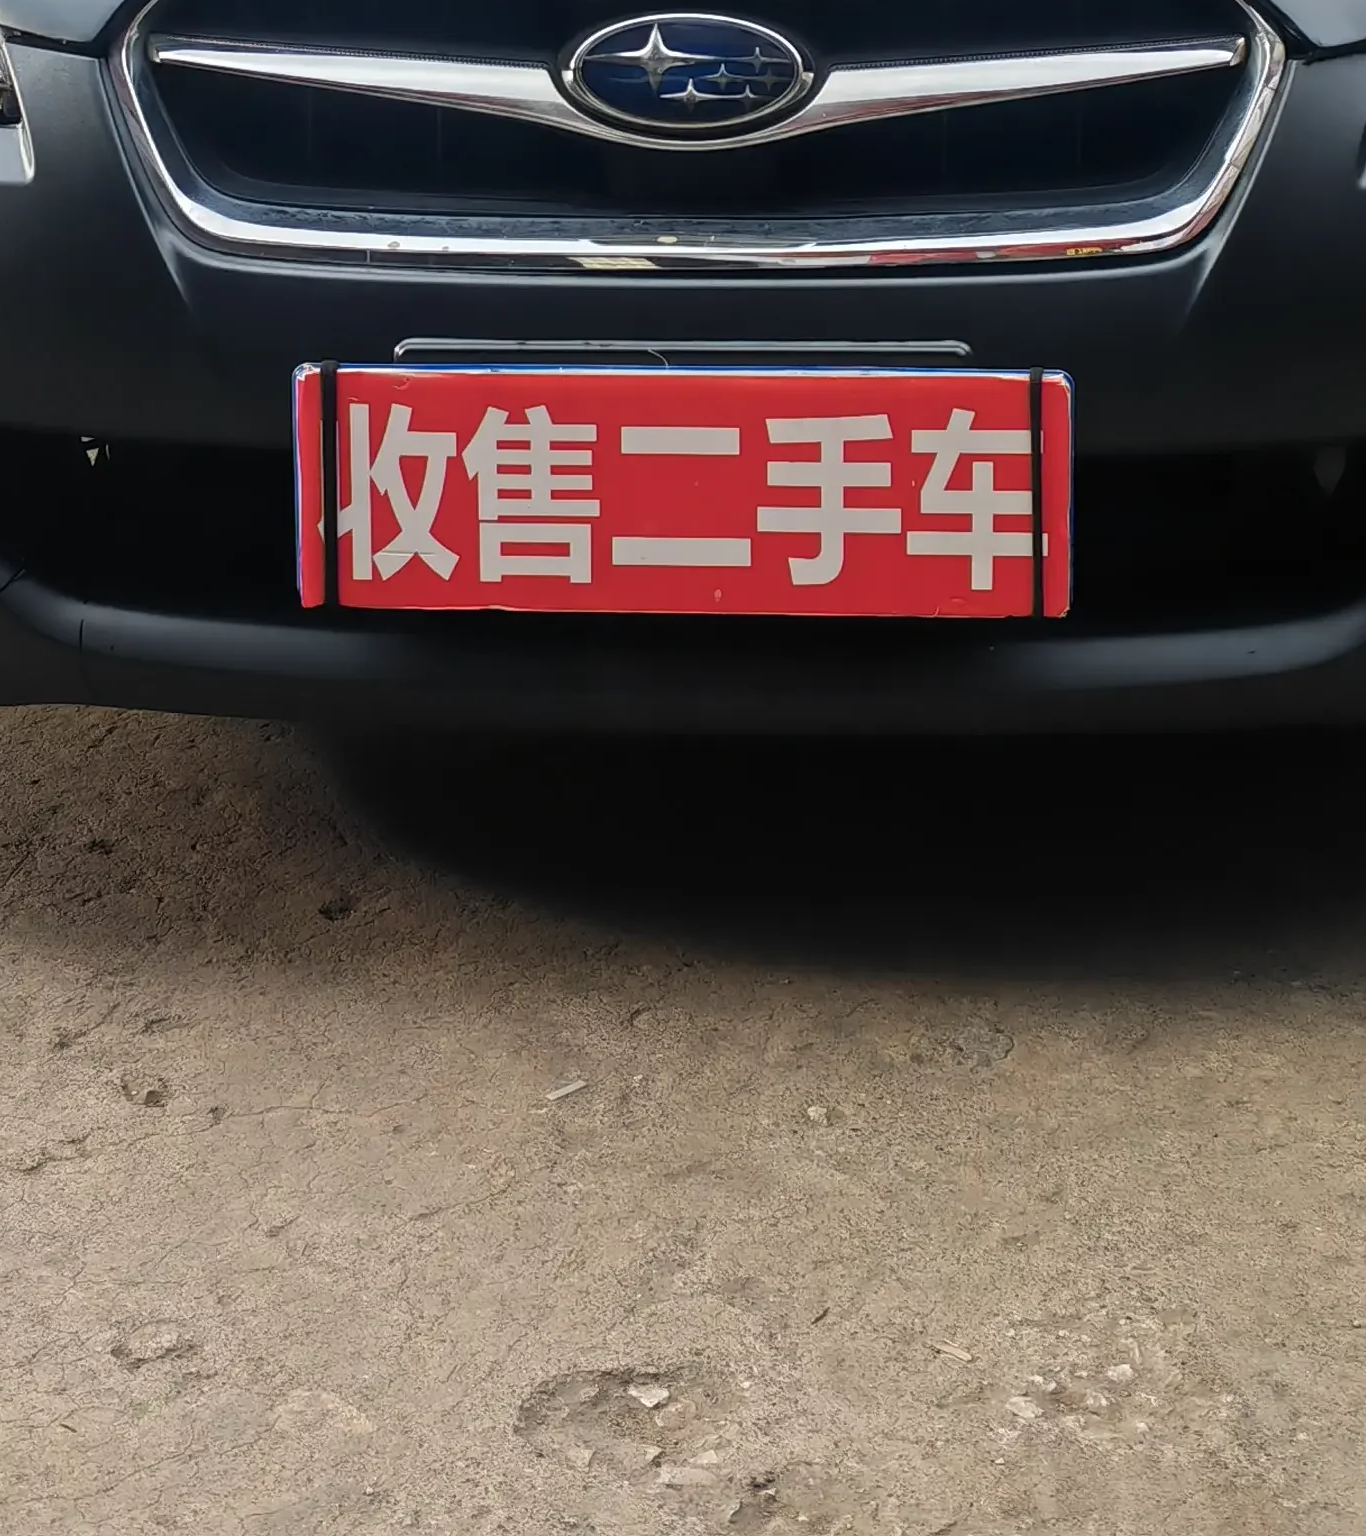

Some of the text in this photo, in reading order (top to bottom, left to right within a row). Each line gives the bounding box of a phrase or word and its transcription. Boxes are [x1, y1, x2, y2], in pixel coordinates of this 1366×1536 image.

[317, 403, 1049, 591] 收售二手车
